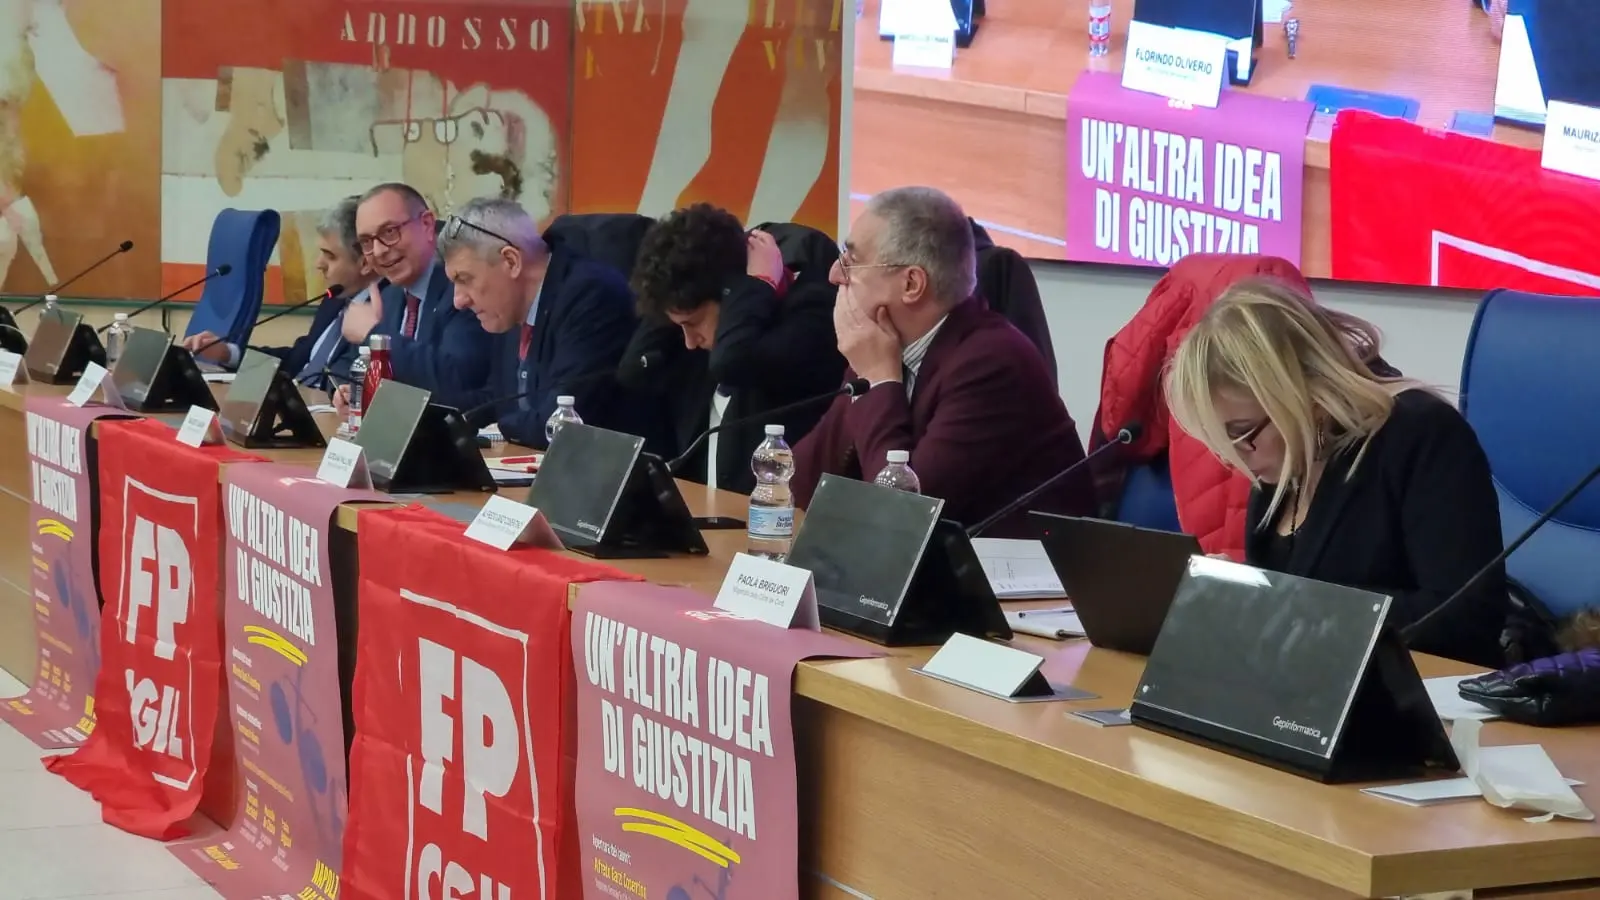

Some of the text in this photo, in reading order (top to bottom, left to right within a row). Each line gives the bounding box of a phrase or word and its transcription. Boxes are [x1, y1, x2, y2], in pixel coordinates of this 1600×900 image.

[1135, 48, 1174, 67] FLORINDO
[1175, 56, 1213, 75] OLIVERIO
[1081, 117, 1282, 222] UN'ALTRA IDEA
[1563, 126, 1600, 144] MAURIZ
[1095, 187, 1120, 253] DI
[126, 515, 191, 660] FP
[229, 483, 322, 588] UN'ALTRA IDEA
[237, 546, 316, 646] DI GIUSTIZIA
[585, 611, 774, 758] UN'ALTRA IDEA
[1272, 715, 1321, 738] Gepinformatica
[418, 637, 519, 842] FP
[602, 698, 757, 840] DI GIUSTIZIA
